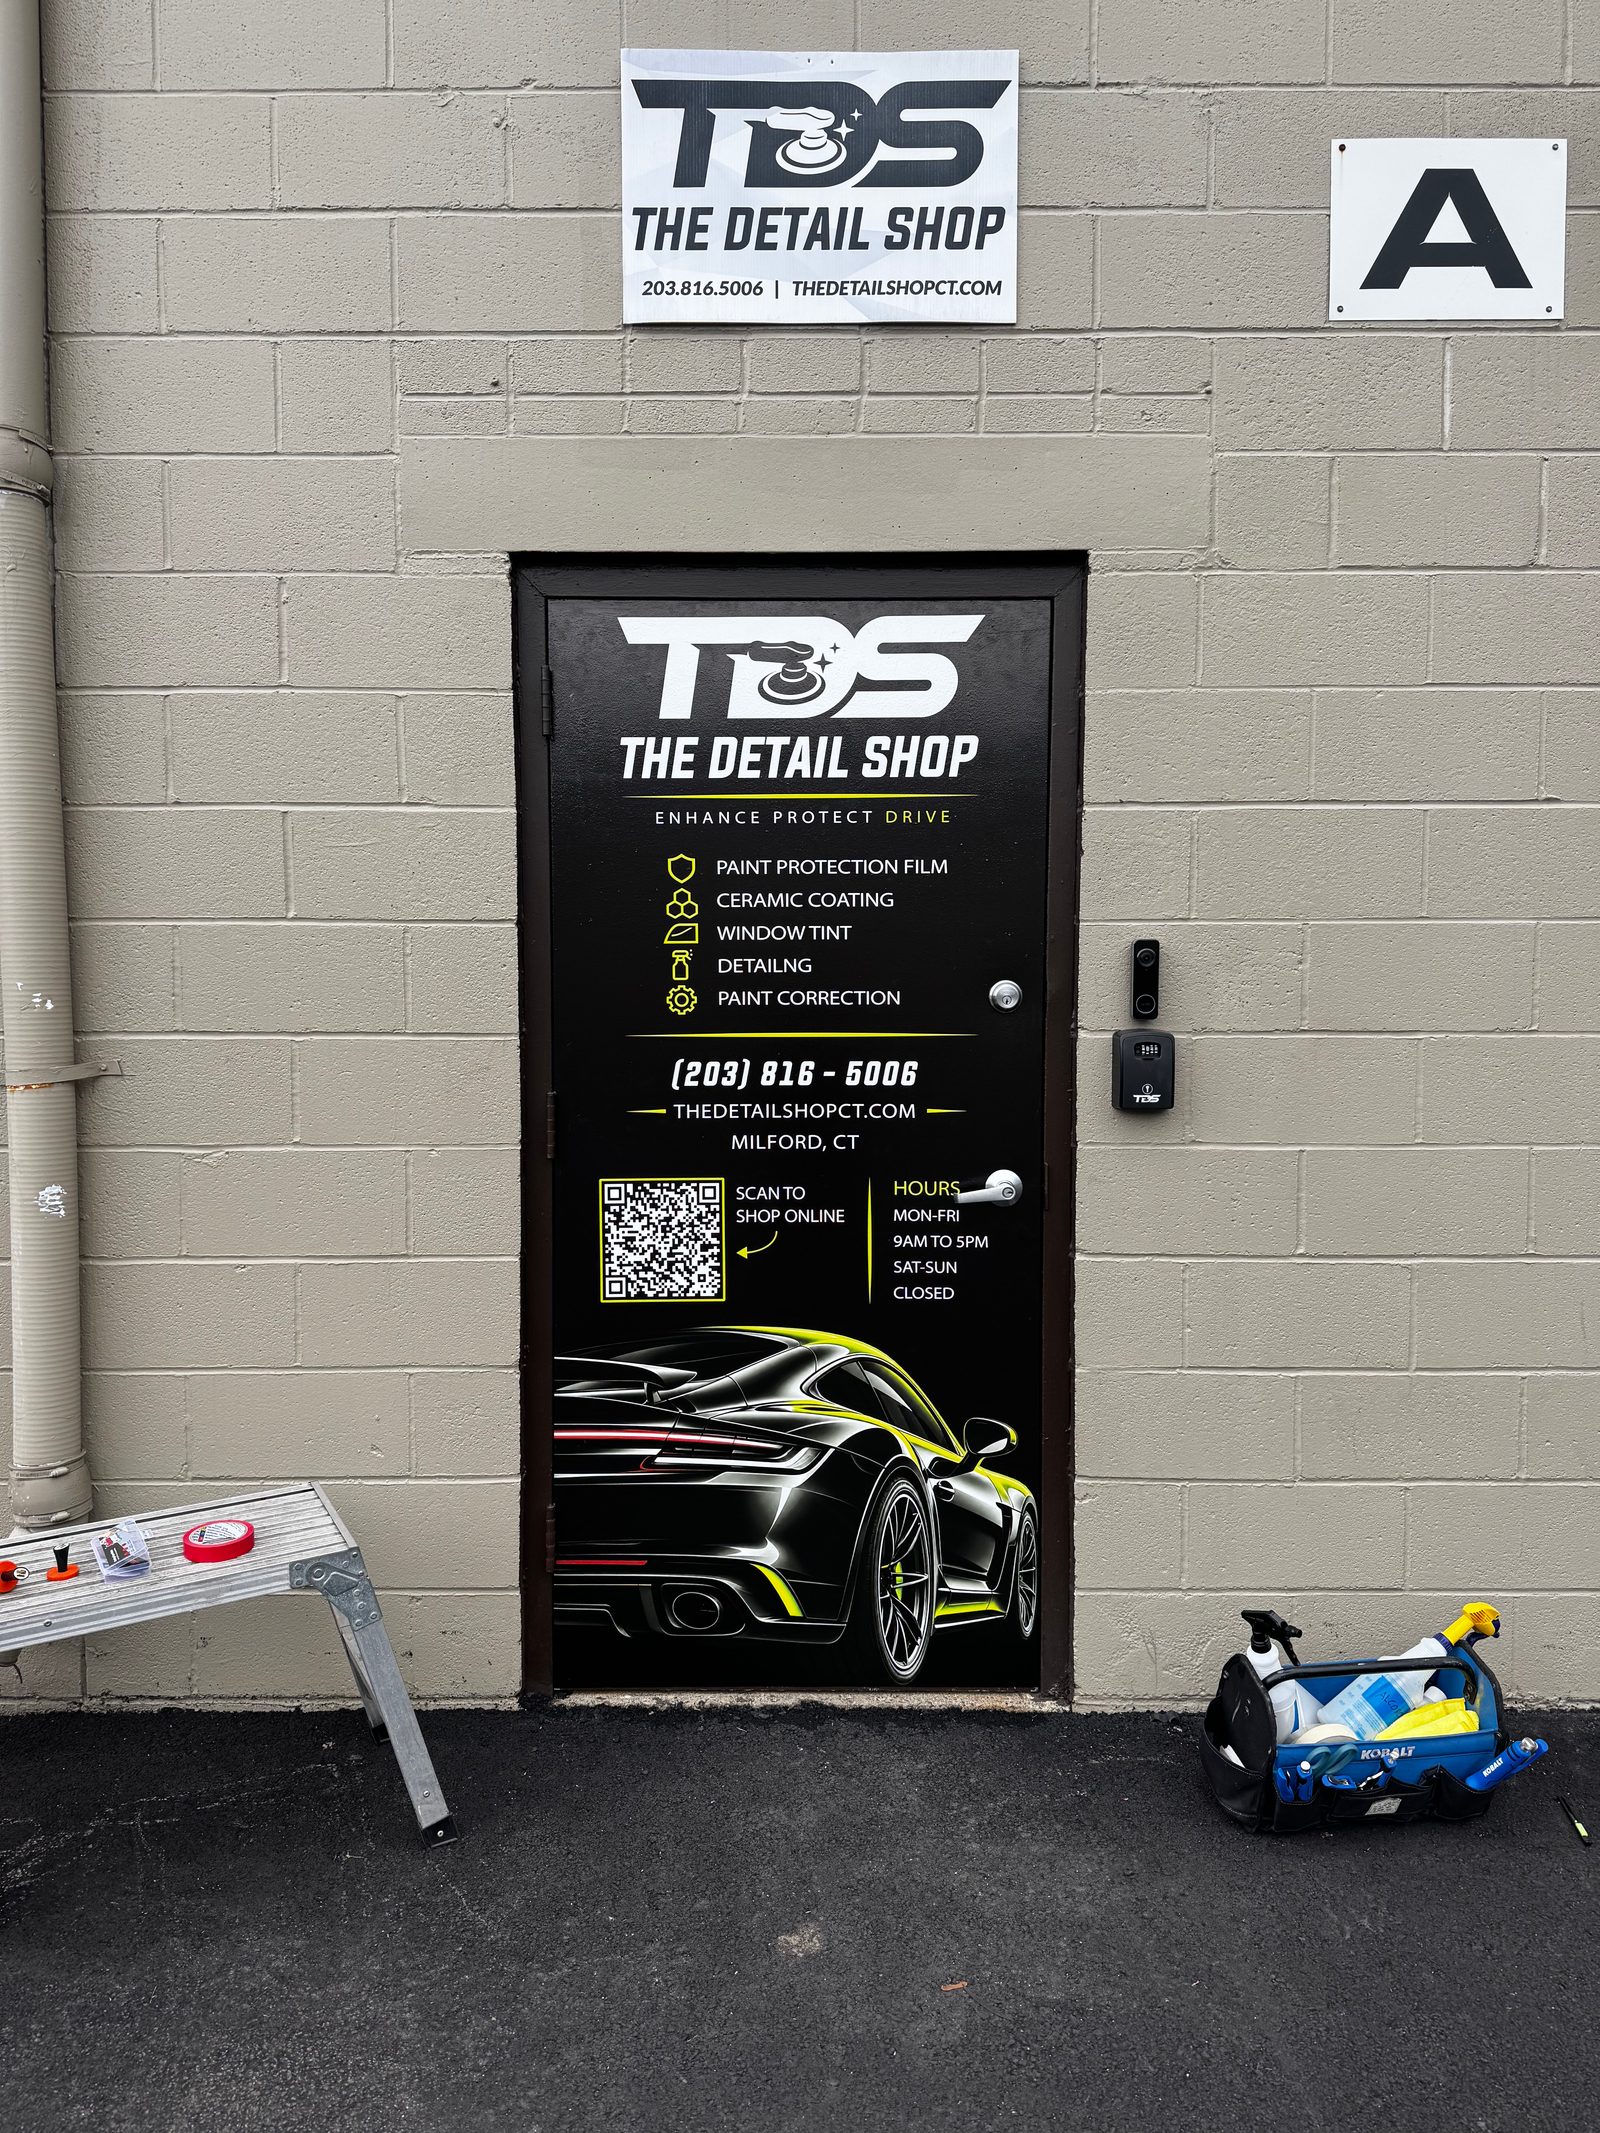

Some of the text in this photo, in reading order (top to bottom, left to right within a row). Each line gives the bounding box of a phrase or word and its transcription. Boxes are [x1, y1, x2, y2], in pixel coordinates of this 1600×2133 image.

[631, 79, 1012, 188] TDS
[632, 206, 1006, 251] THE DETAIL SHOP
[1359, 168, 1534, 290] A
[642, 280, 764, 296] 203.816.5006
[792, 280, 1003, 296] THEDETAILSHOPCT.COM
[616, 614, 986, 720] TDS
[619, 735, 980, 779] THE DETAIL SHOP
[655, 810, 951, 825] ENHANCE PROTECT DRIVE
[716, 859, 948, 875] PAINT PROTECTION FILM
[716, 892, 894, 908] CERAMIC COATING
[717, 925, 853, 941] WINDOW TINT
[718, 958, 812, 974] DETAILNG
[718, 990, 901, 1006] PAINT CORRECTION
[671, 1058, 751, 1091] (203)
[760, 1060, 816, 1086] 816
[845, 1060, 919, 1087] 5006
[1132, 1094, 1162, 1103] TDS
[673, 1103, 916, 1119] THEDETAILSHOPCT.COM
[731, 1134, 860, 1152] MILFORD, CT
[736, 1186, 806, 1200] SCAN TO
[893, 1180, 960, 1196] HOURS
[736, 1209, 845, 1223] SHOP ONLINE
[894, 1208, 960, 1222] MON-FRI
[893, 1234, 989, 1249] 9AM TO 5PM
[893, 1260, 957, 1274] SAT-SUN
[893, 1286, 955, 1300] CLOSED
[1482, 1757, 1504, 1777] KOBALT
